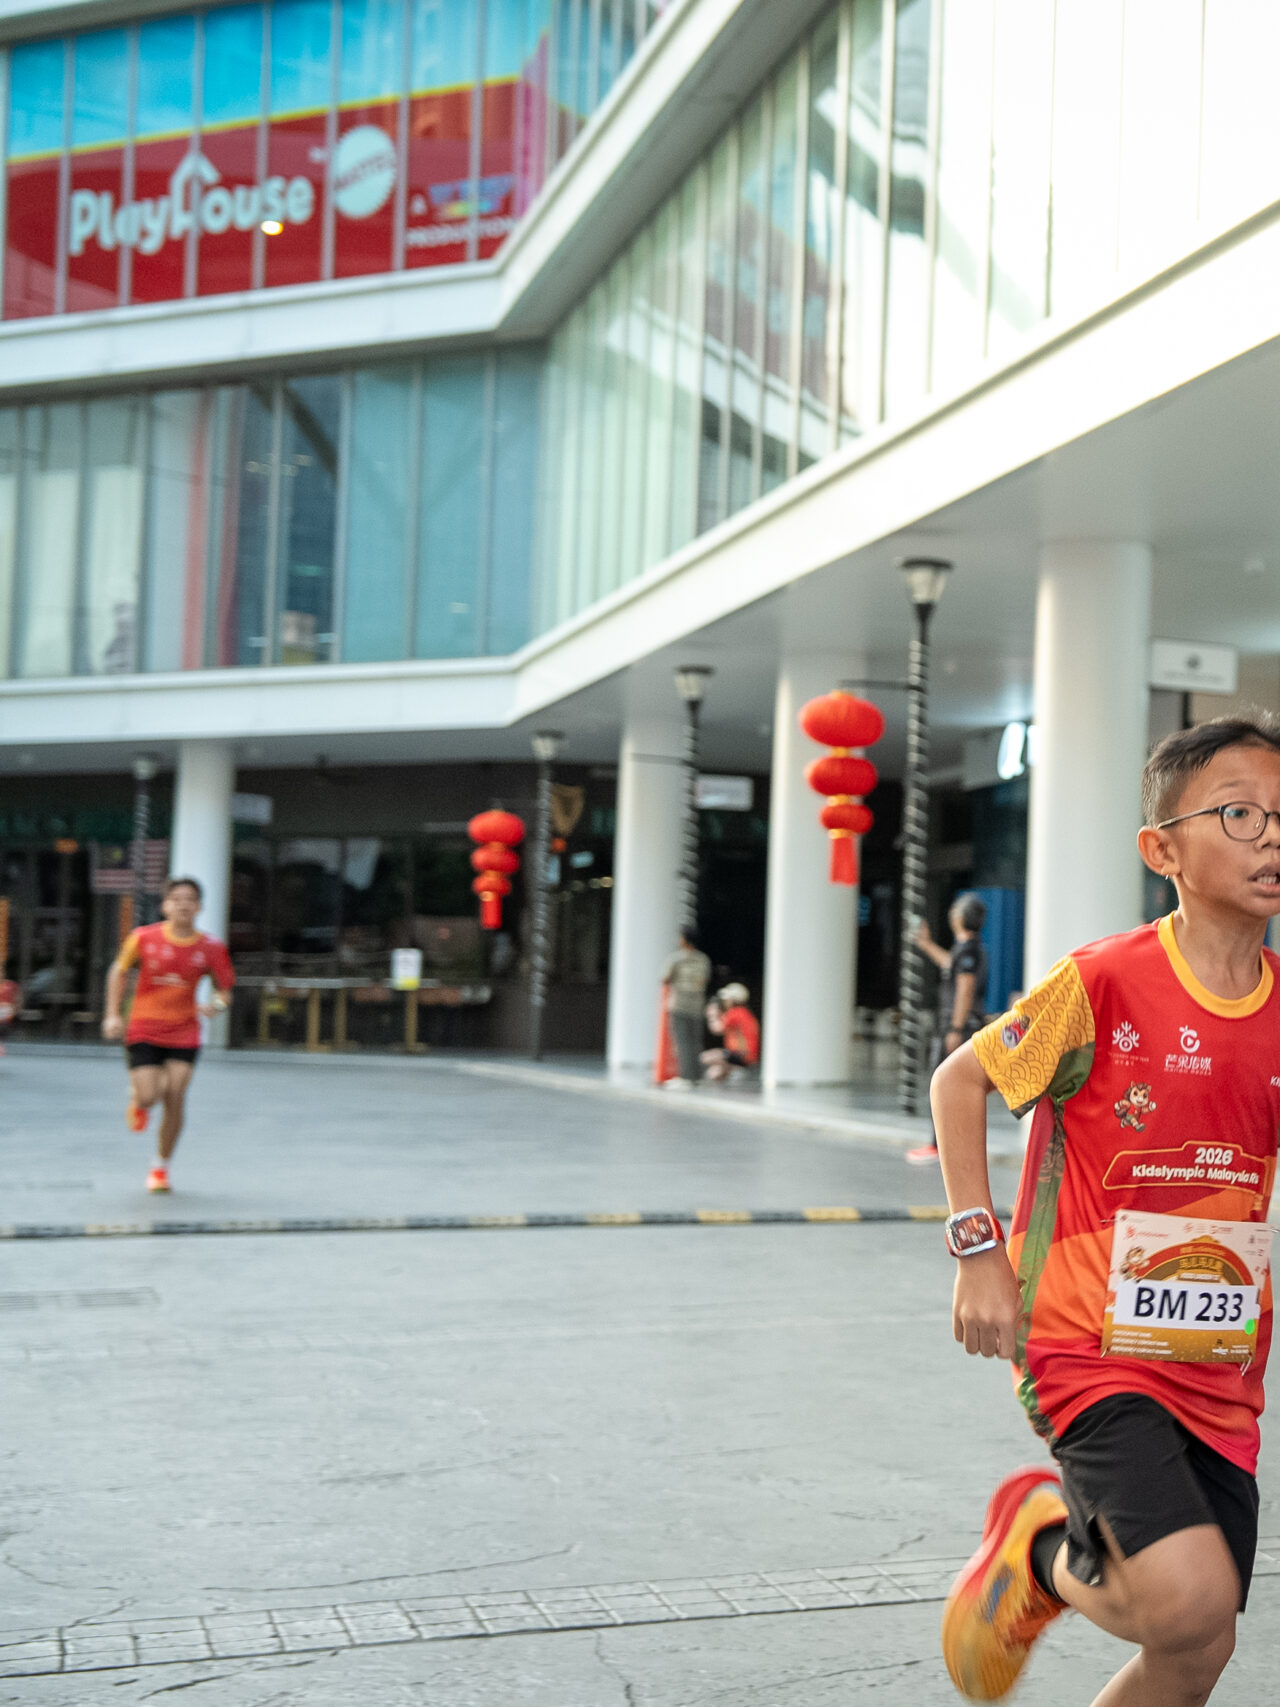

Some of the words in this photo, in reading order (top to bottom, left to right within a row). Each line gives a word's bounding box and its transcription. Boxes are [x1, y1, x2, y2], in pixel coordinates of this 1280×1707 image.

[1194, 1147, 1234, 1166] 2026
[1132, 1164, 1205, 1181] Kidslympic
[1134, 1286, 1189, 1321] BM
[1194, 1291, 1245, 1323] 233
